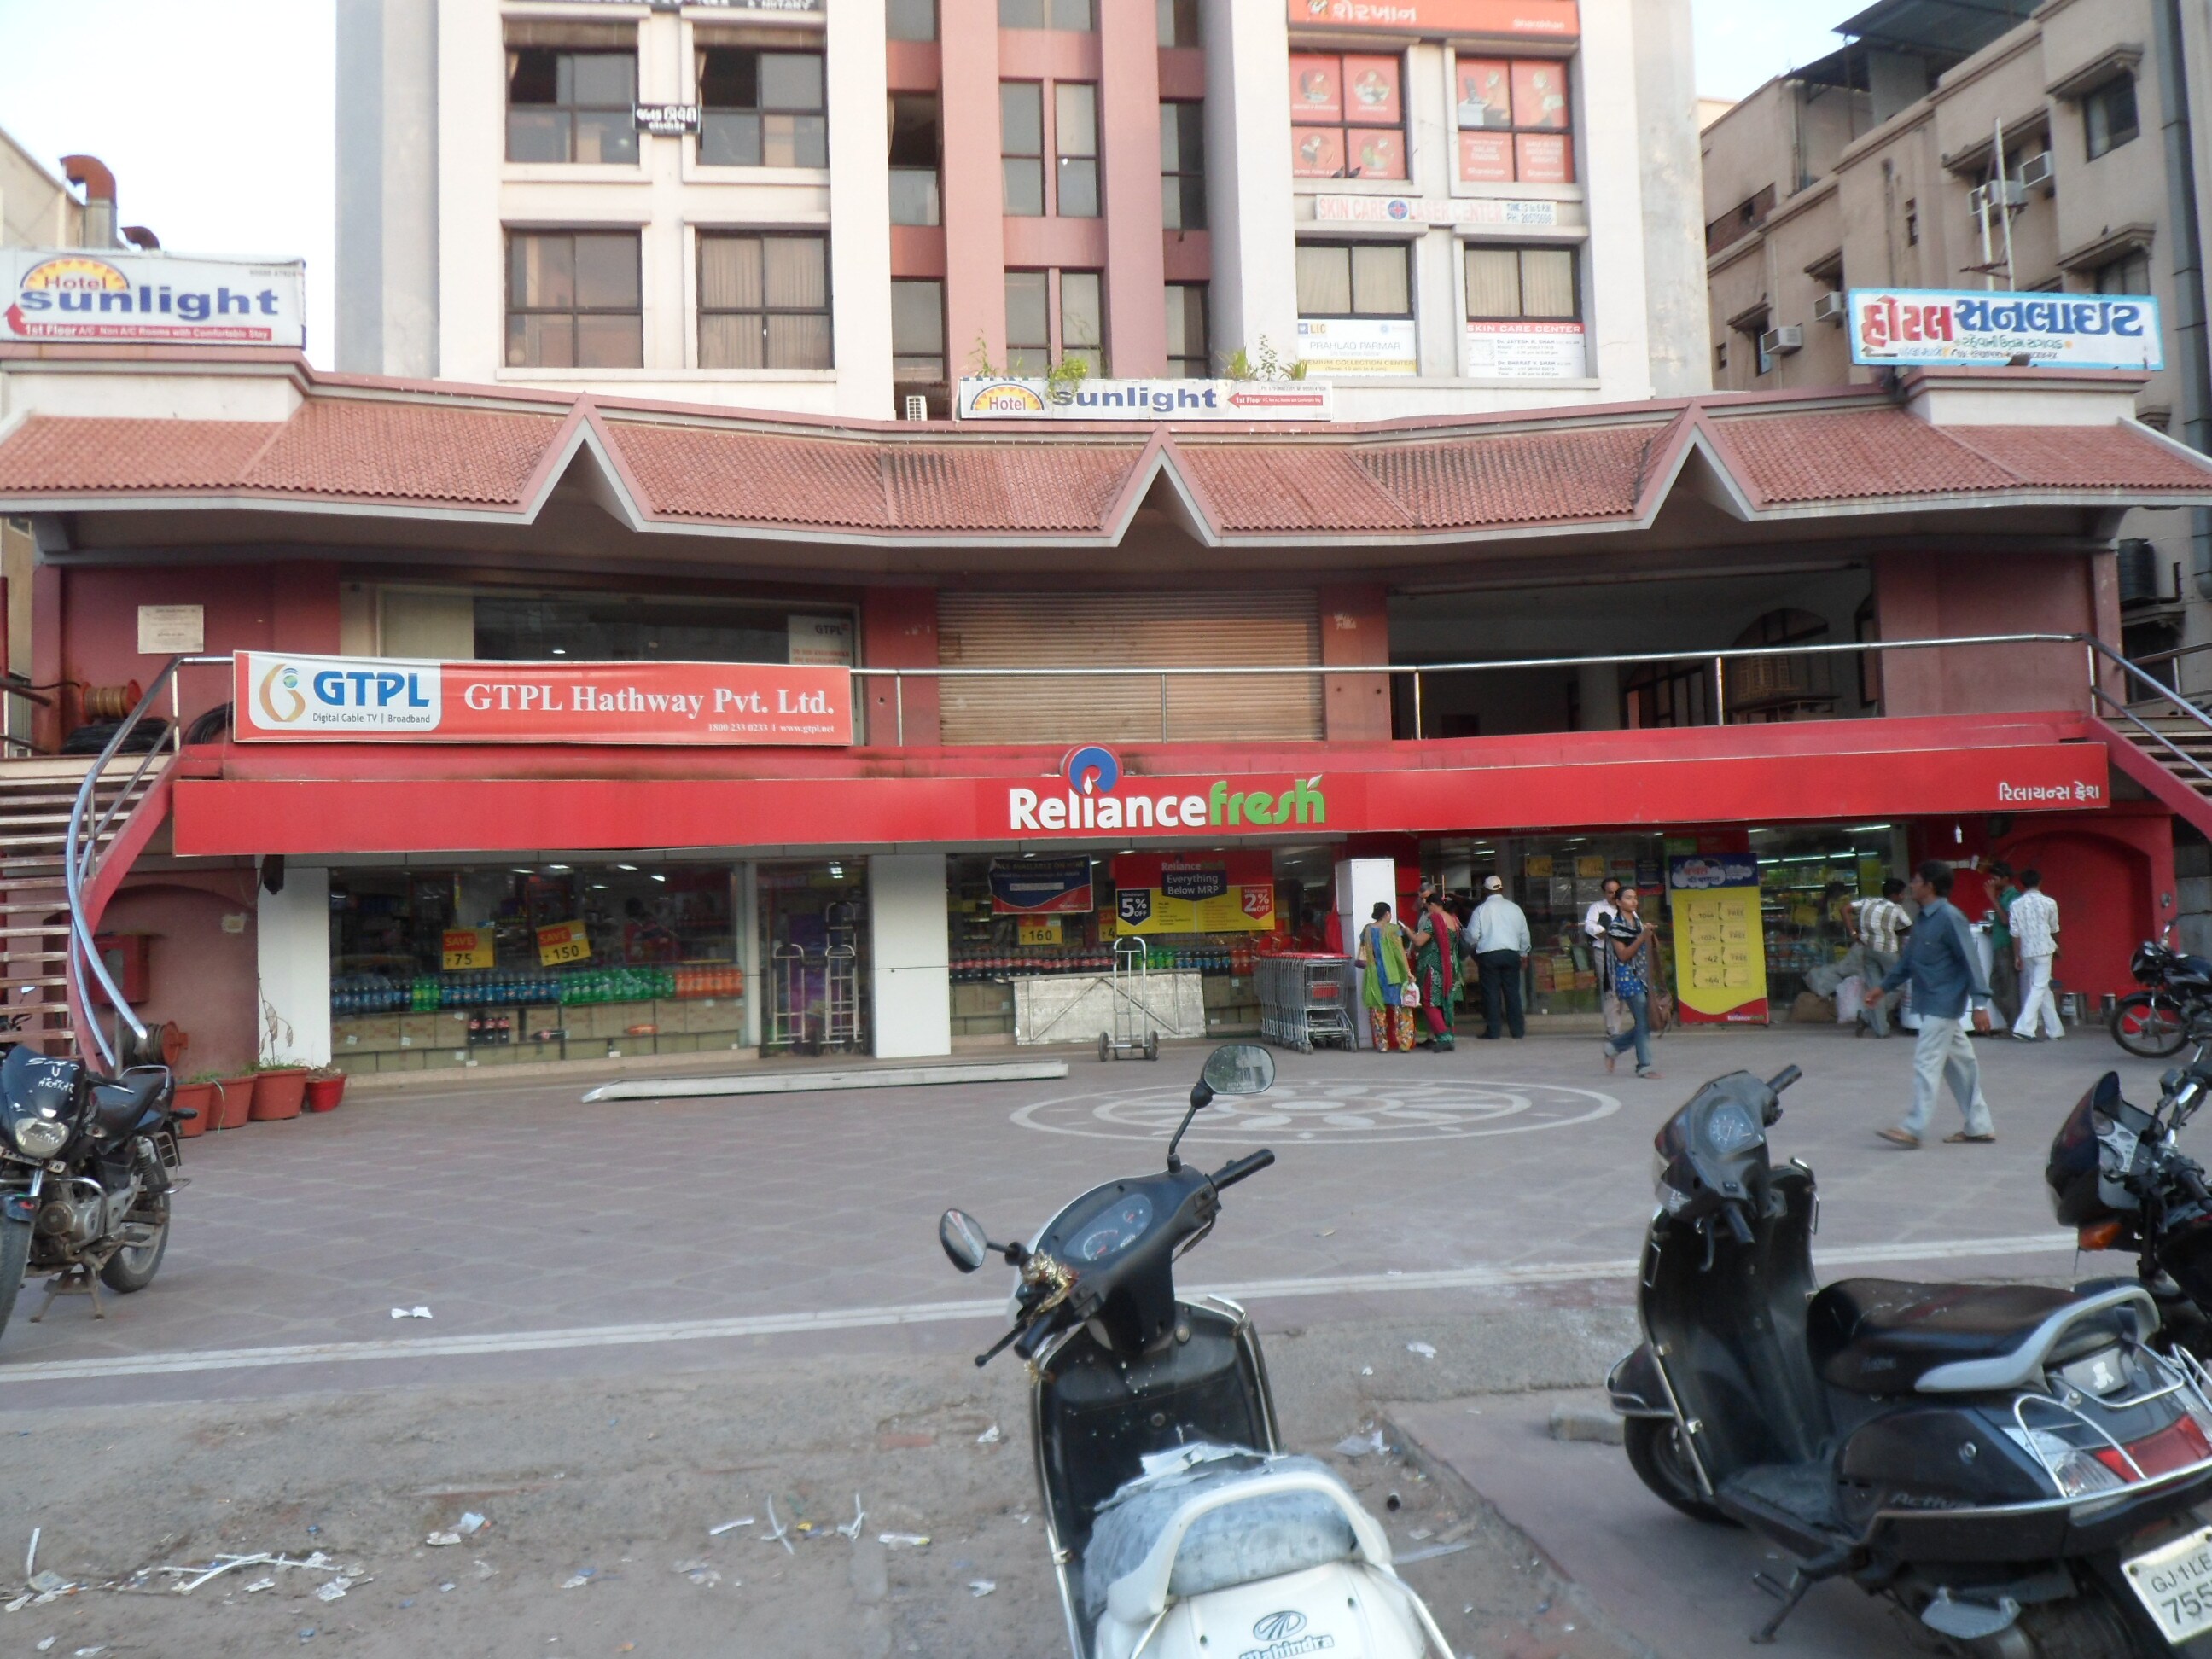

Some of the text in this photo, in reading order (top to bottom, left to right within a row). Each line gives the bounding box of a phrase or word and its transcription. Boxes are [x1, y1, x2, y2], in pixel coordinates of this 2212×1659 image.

[1319, 198, 1387, 219] SKIN CARE
[1409, 201, 1449, 221] LASER
[44, 276, 108, 290] Hotel
[21, 286, 279, 322] sunlight
[26, 324, 44, 336] 1st
[46, 324, 77, 336] Floor
[1310, 323, 1326, 335] LIC
[1499, 325, 1532, 334] CARE
[1535, 325, 1581, 334] CENTER
[1310, 341, 1401, 351] PRAHLAD PARMAR
[988, 396, 1027, 411] Hotel
[1051, 387, 1217, 412] sunlight
[1246, 396, 1262, 405] Floor
[815, 624, 843, 635] GTPL
[313, 670, 430, 707] GTPL
[464, 684, 835, 719] GTPL Hathway Pvt. Ltd.
[312, 713, 340, 724] Digital
[341, 713, 364, 723] Cable
[387, 714, 431, 723] Broadband
[708, 724, 835, 735] 1800 233 0233 www.gtpl.net
[1999, 780, 2100, 802] રિલાયન્સ ફ્રેશ
[1167, 874, 1219, 885] Everything
[1167, 886, 1220, 895] Below MRP
[1727, 908, 1744, 917] FREE
[446, 936, 474, 946] SAVE
[540, 930, 568, 944] SAVE
[1028, 930, 1052, 941] 160
[553, 945, 579, 960] 150
[454, 953, 473, 965] 75
[1238, 1633, 1336, 1659] Mahindra
